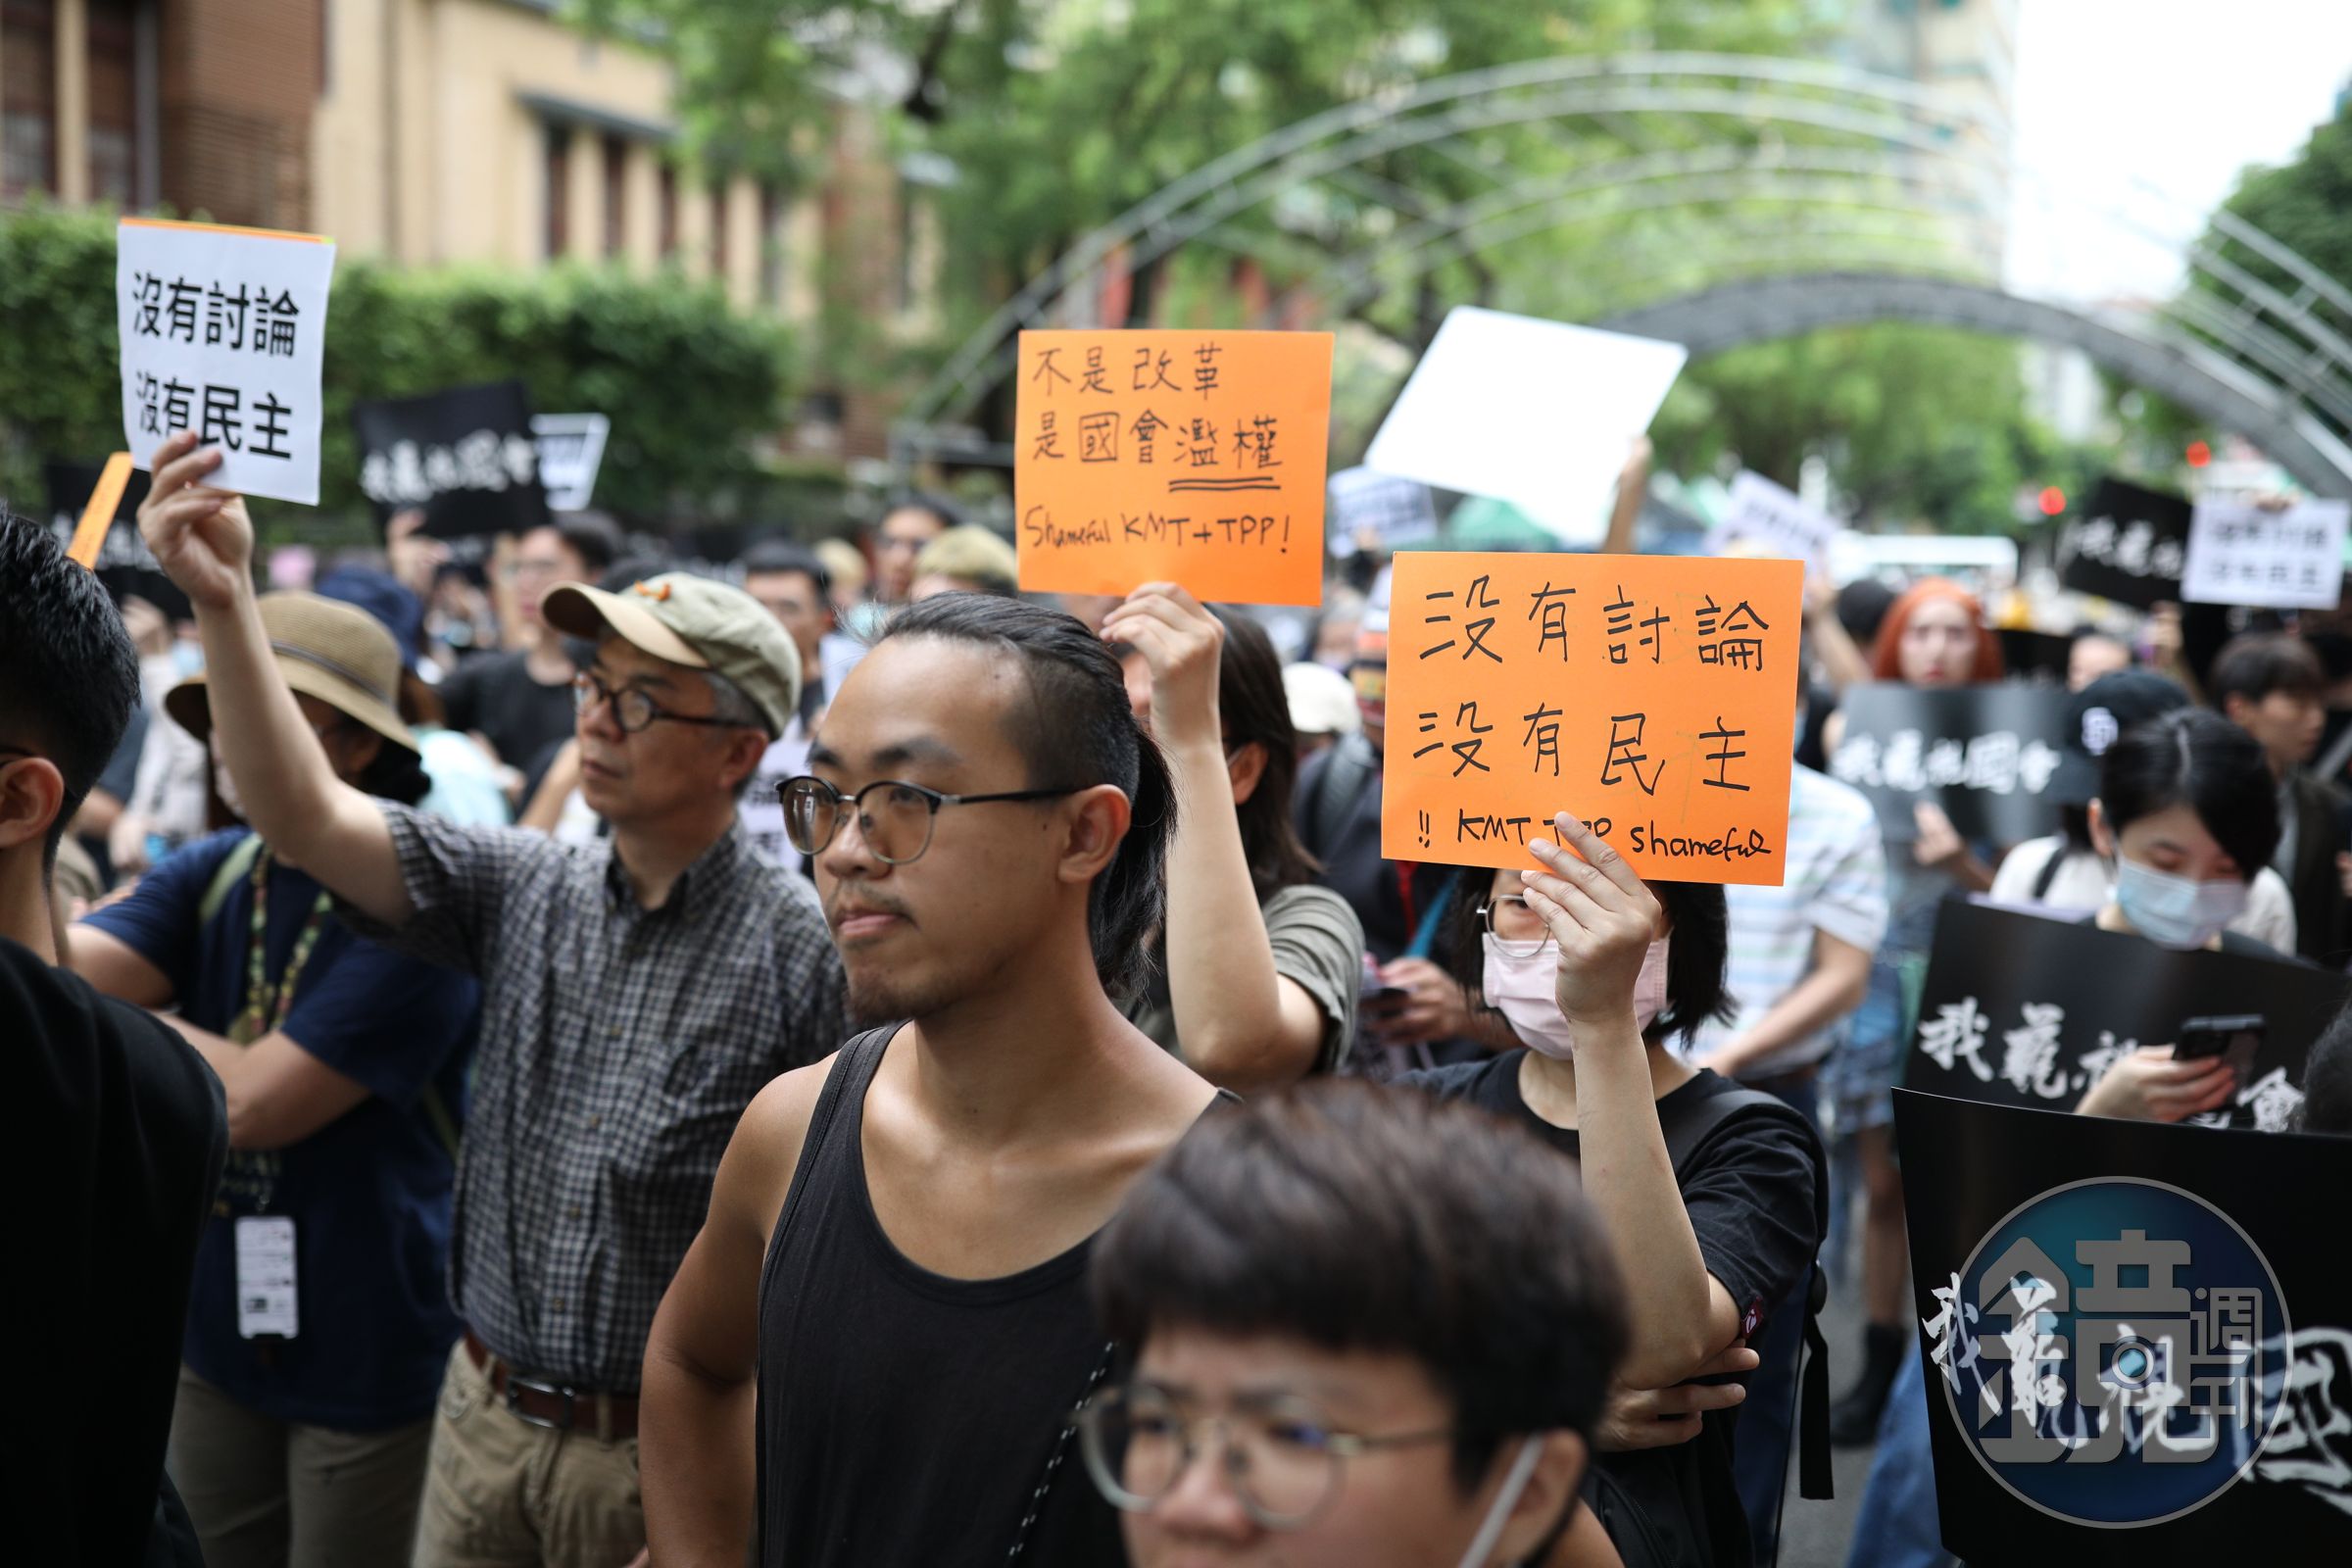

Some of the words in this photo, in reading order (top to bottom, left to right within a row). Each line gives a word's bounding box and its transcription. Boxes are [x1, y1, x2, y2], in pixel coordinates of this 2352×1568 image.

[133, 271, 299, 359] 沒有討論
[1033, 342, 1222, 400] 不是改革
[136, 370, 292, 460] 沒有民主
[1033, 409, 1283, 469] 是國會濫權
[1457, 808, 1531, 845] KMT
[1543, 816, 1612, 848] TP
